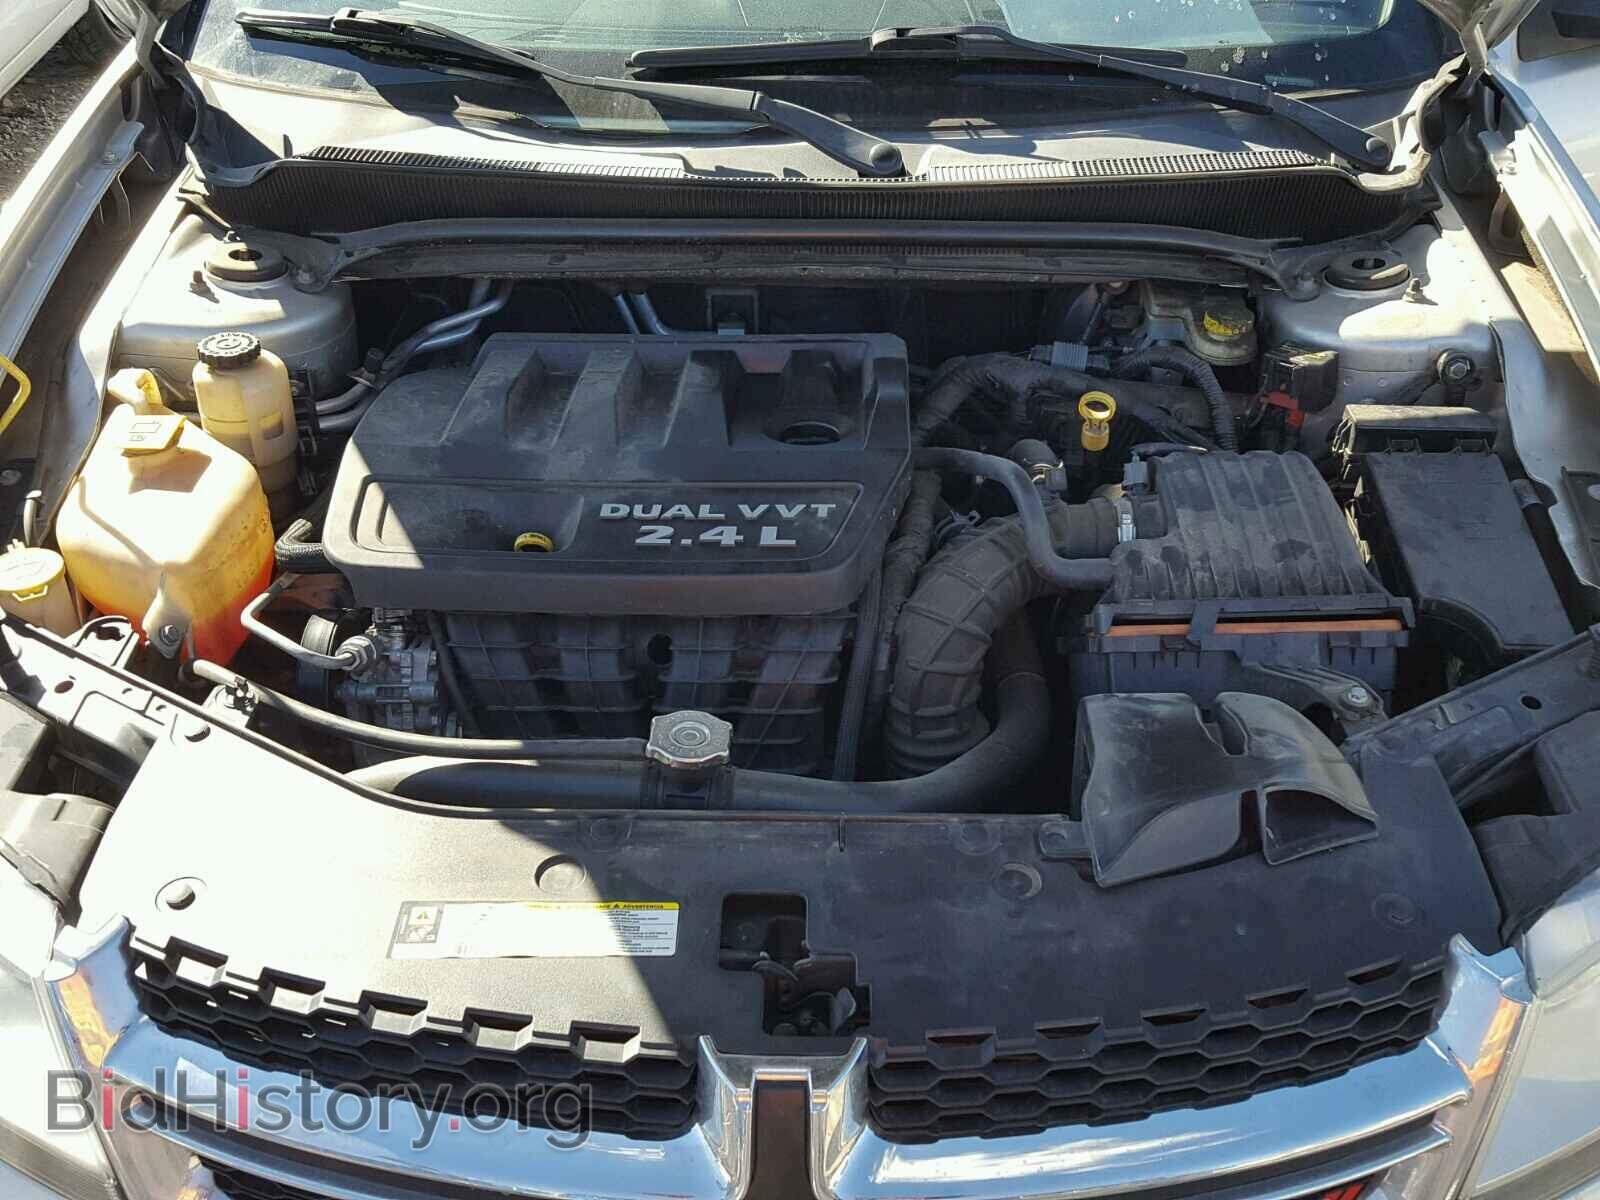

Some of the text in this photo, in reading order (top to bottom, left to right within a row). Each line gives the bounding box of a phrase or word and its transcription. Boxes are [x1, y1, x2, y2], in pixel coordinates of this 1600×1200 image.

[600, 503, 836, 520] DUAL VVT
[635, 525, 797, 547] 2.4 L
